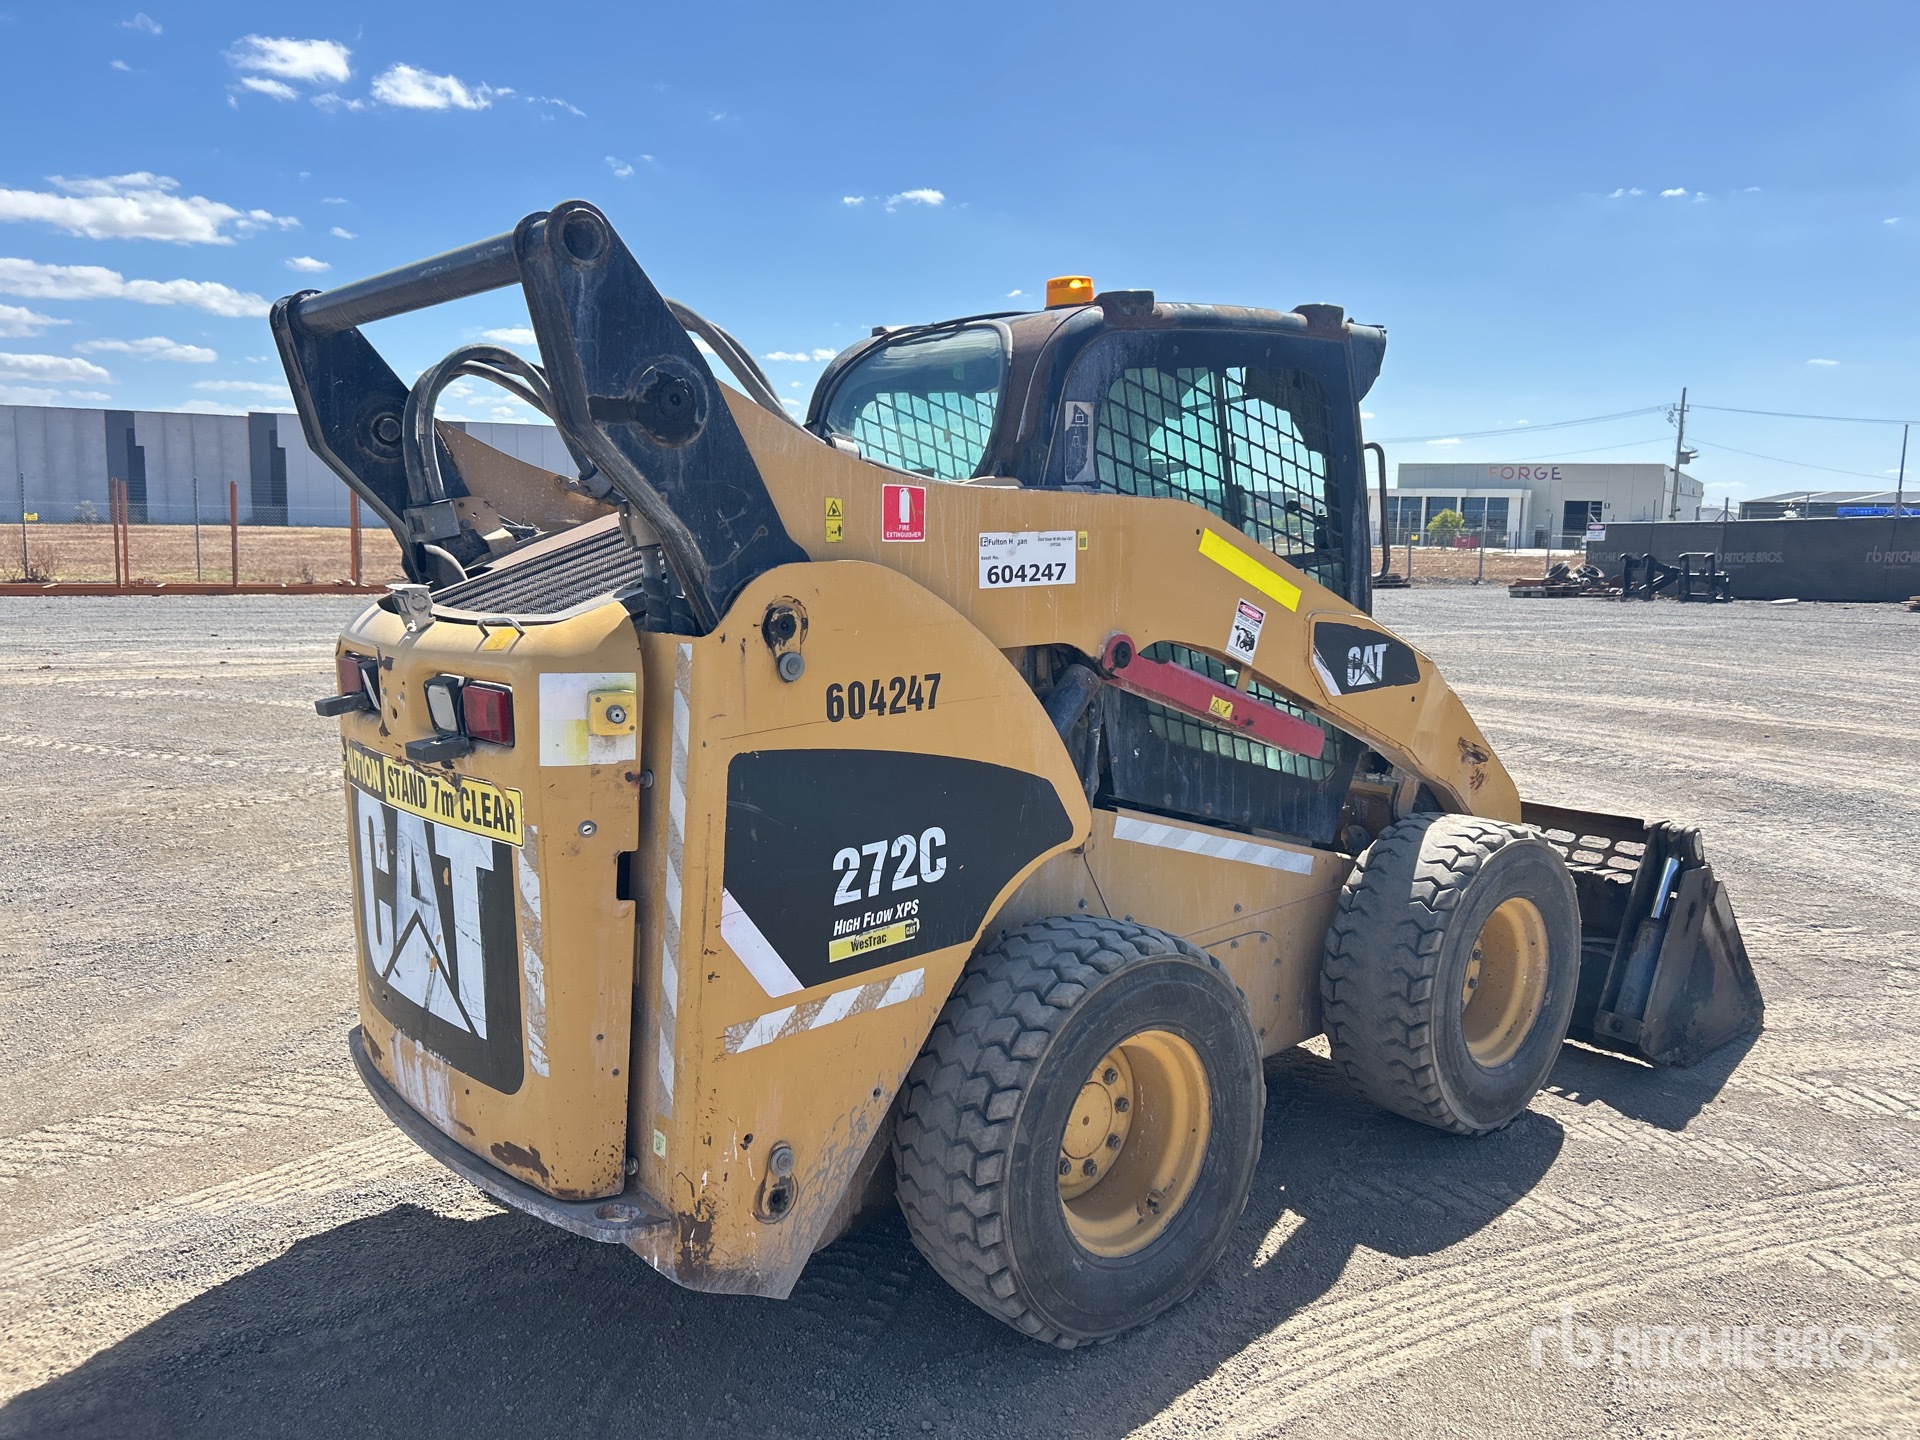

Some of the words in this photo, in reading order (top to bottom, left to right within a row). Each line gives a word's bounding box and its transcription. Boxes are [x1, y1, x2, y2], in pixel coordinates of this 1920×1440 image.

[1488, 466, 1562, 480] FORGE
[988, 538, 1008, 546] Fulton
[1008, 538, 1028, 547] Hgan
[1724, 551, 1755, 563] RITCHIE
[987, 562, 1067, 585] 604247
[1346, 642, 1388, 687] CAT
[826, 672, 941, 723] 604247
[387, 764, 427, 809] STAND
[430, 780, 456, 819] 7m
[459, 786, 517, 835] CLEAR
[832, 826, 947, 907] 272C
[358, 783, 494, 1041] CAT
[894, 898, 920, 920] XPS
[905, 925, 917, 935] CAT
[850, 933, 887, 952] WesTrac
